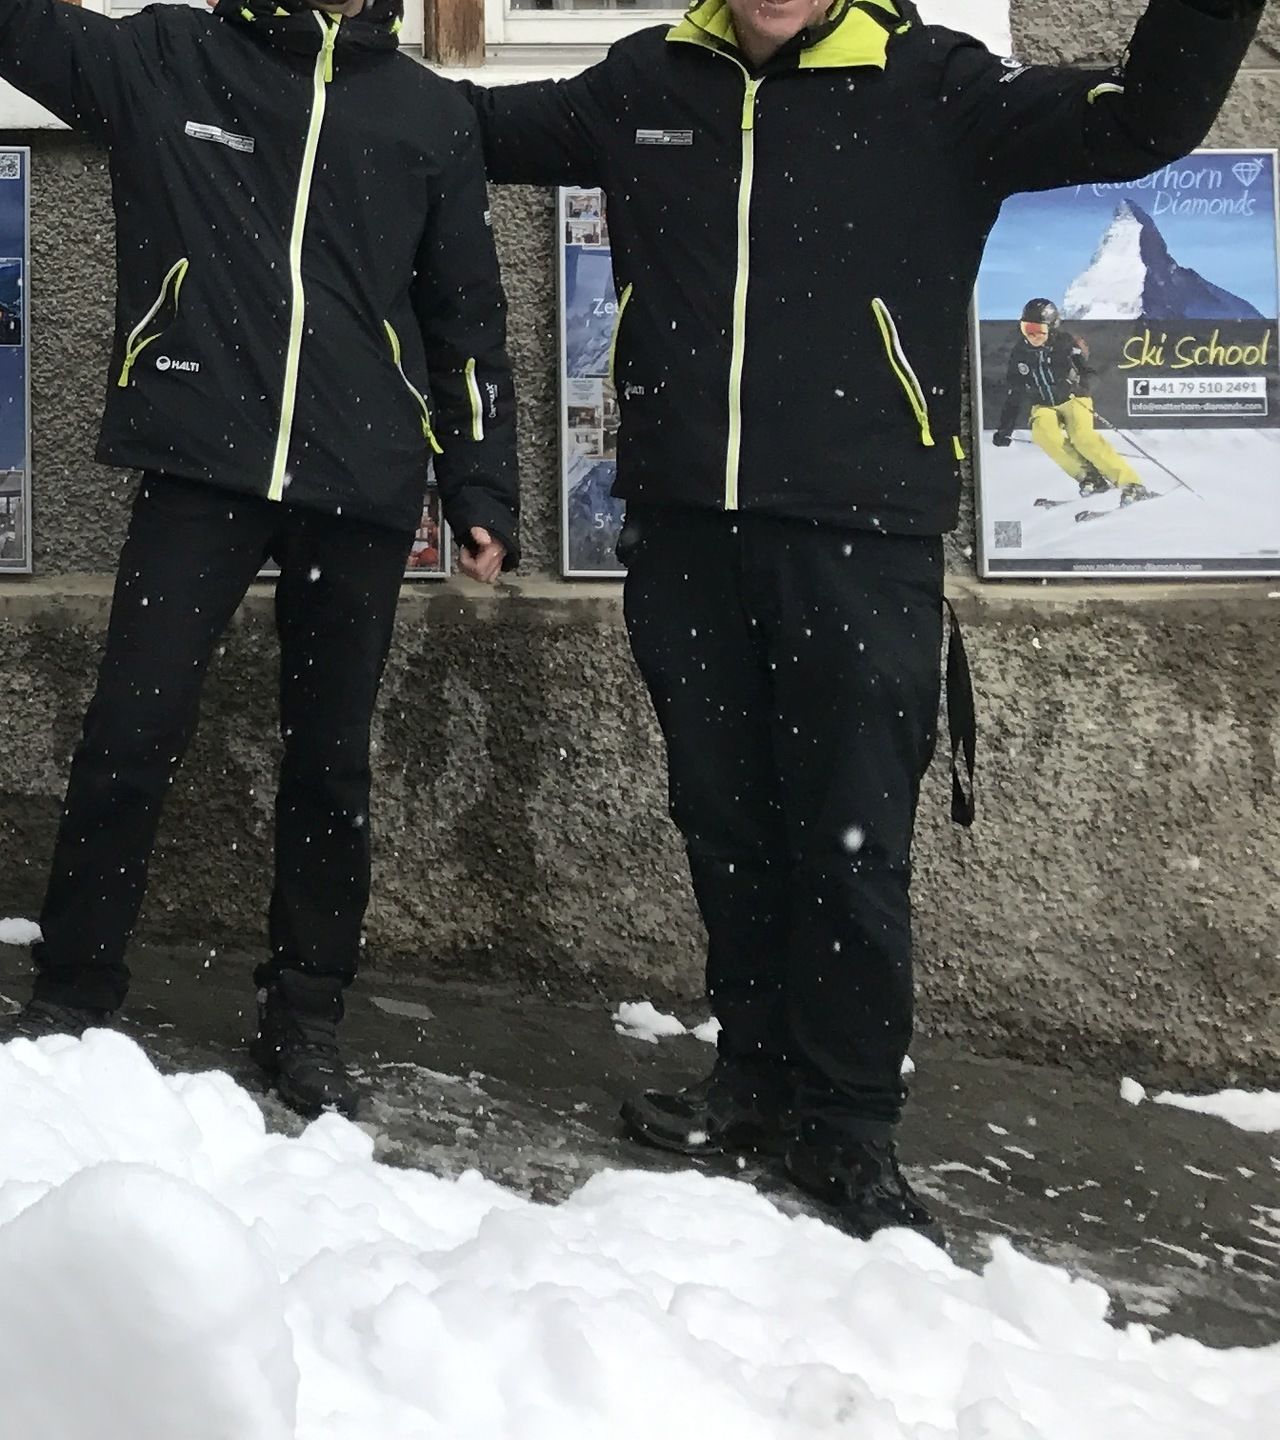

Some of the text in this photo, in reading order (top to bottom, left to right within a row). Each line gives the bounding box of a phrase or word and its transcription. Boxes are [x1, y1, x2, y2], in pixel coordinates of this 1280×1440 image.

[1152, 189, 1257, 217] Diamonds
[1117, 328, 1271, 369] Ski School
[171, 360, 200, 372] HALTI
[1151, 381, 1258, 394] +41 79 510 2491
